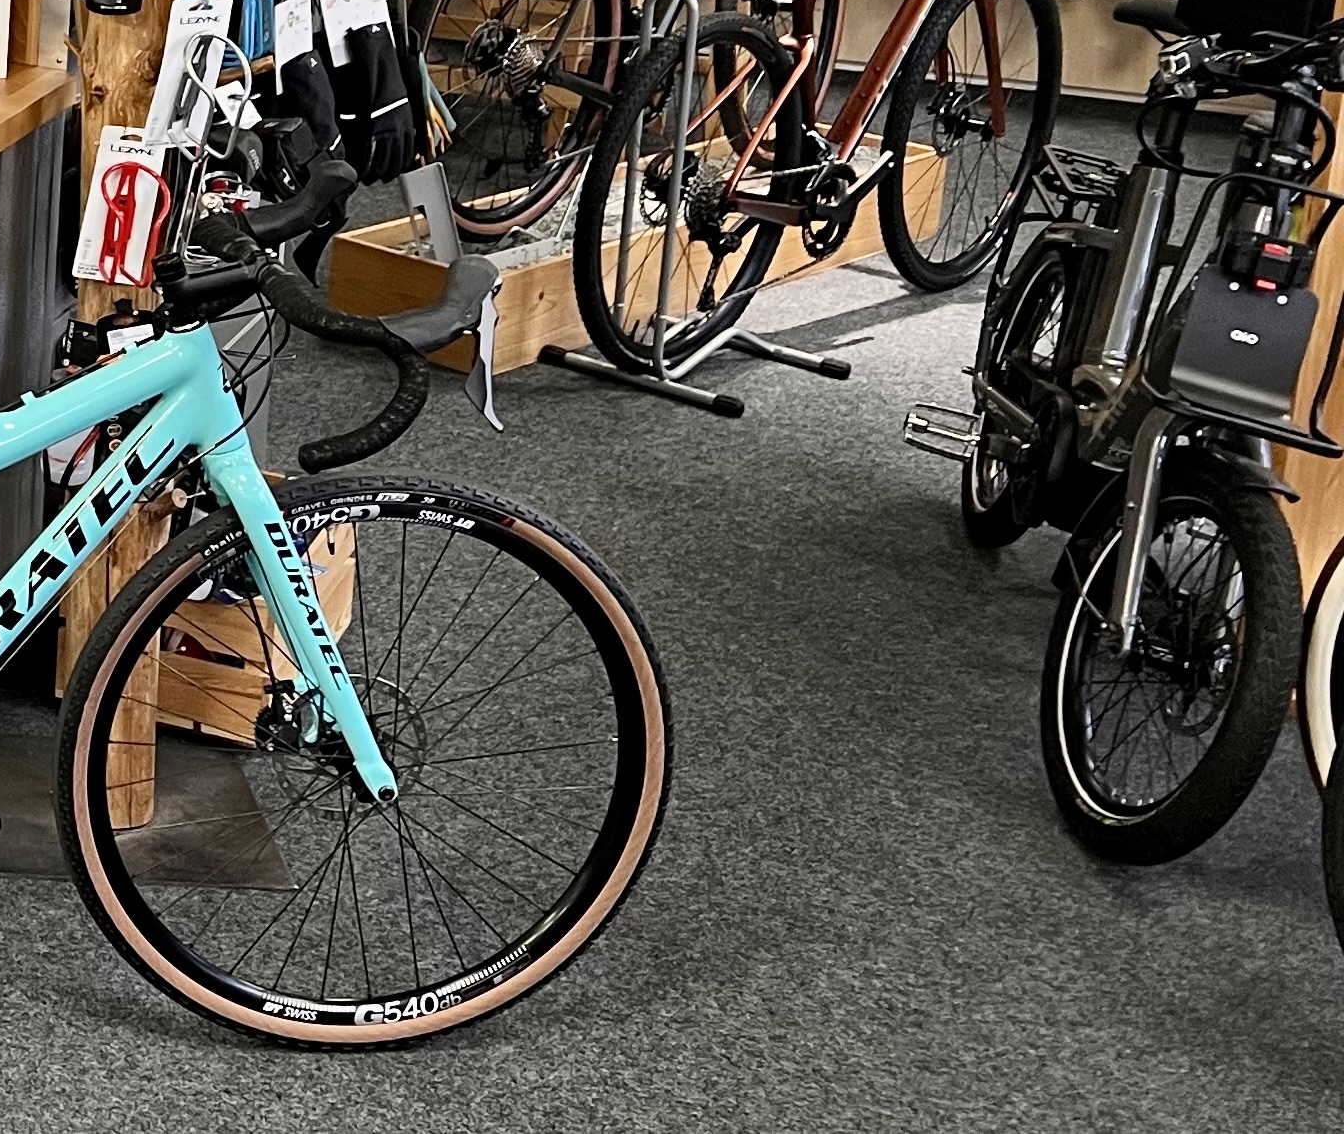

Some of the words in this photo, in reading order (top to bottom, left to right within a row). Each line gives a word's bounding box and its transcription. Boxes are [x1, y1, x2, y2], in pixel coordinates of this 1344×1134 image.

[110, 144, 156, 157] LEZYNE
[291, 500, 328, 516] GRAVEL
[329, 494, 374, 506] GRINDER
[285, 503, 381, 537] G540d
[418, 509, 454, 524] SWISS
[203, 529, 243, 558] challe
[263, 522, 350, 692] DURATEC
[283, 1006, 319, 1022] SWISS
